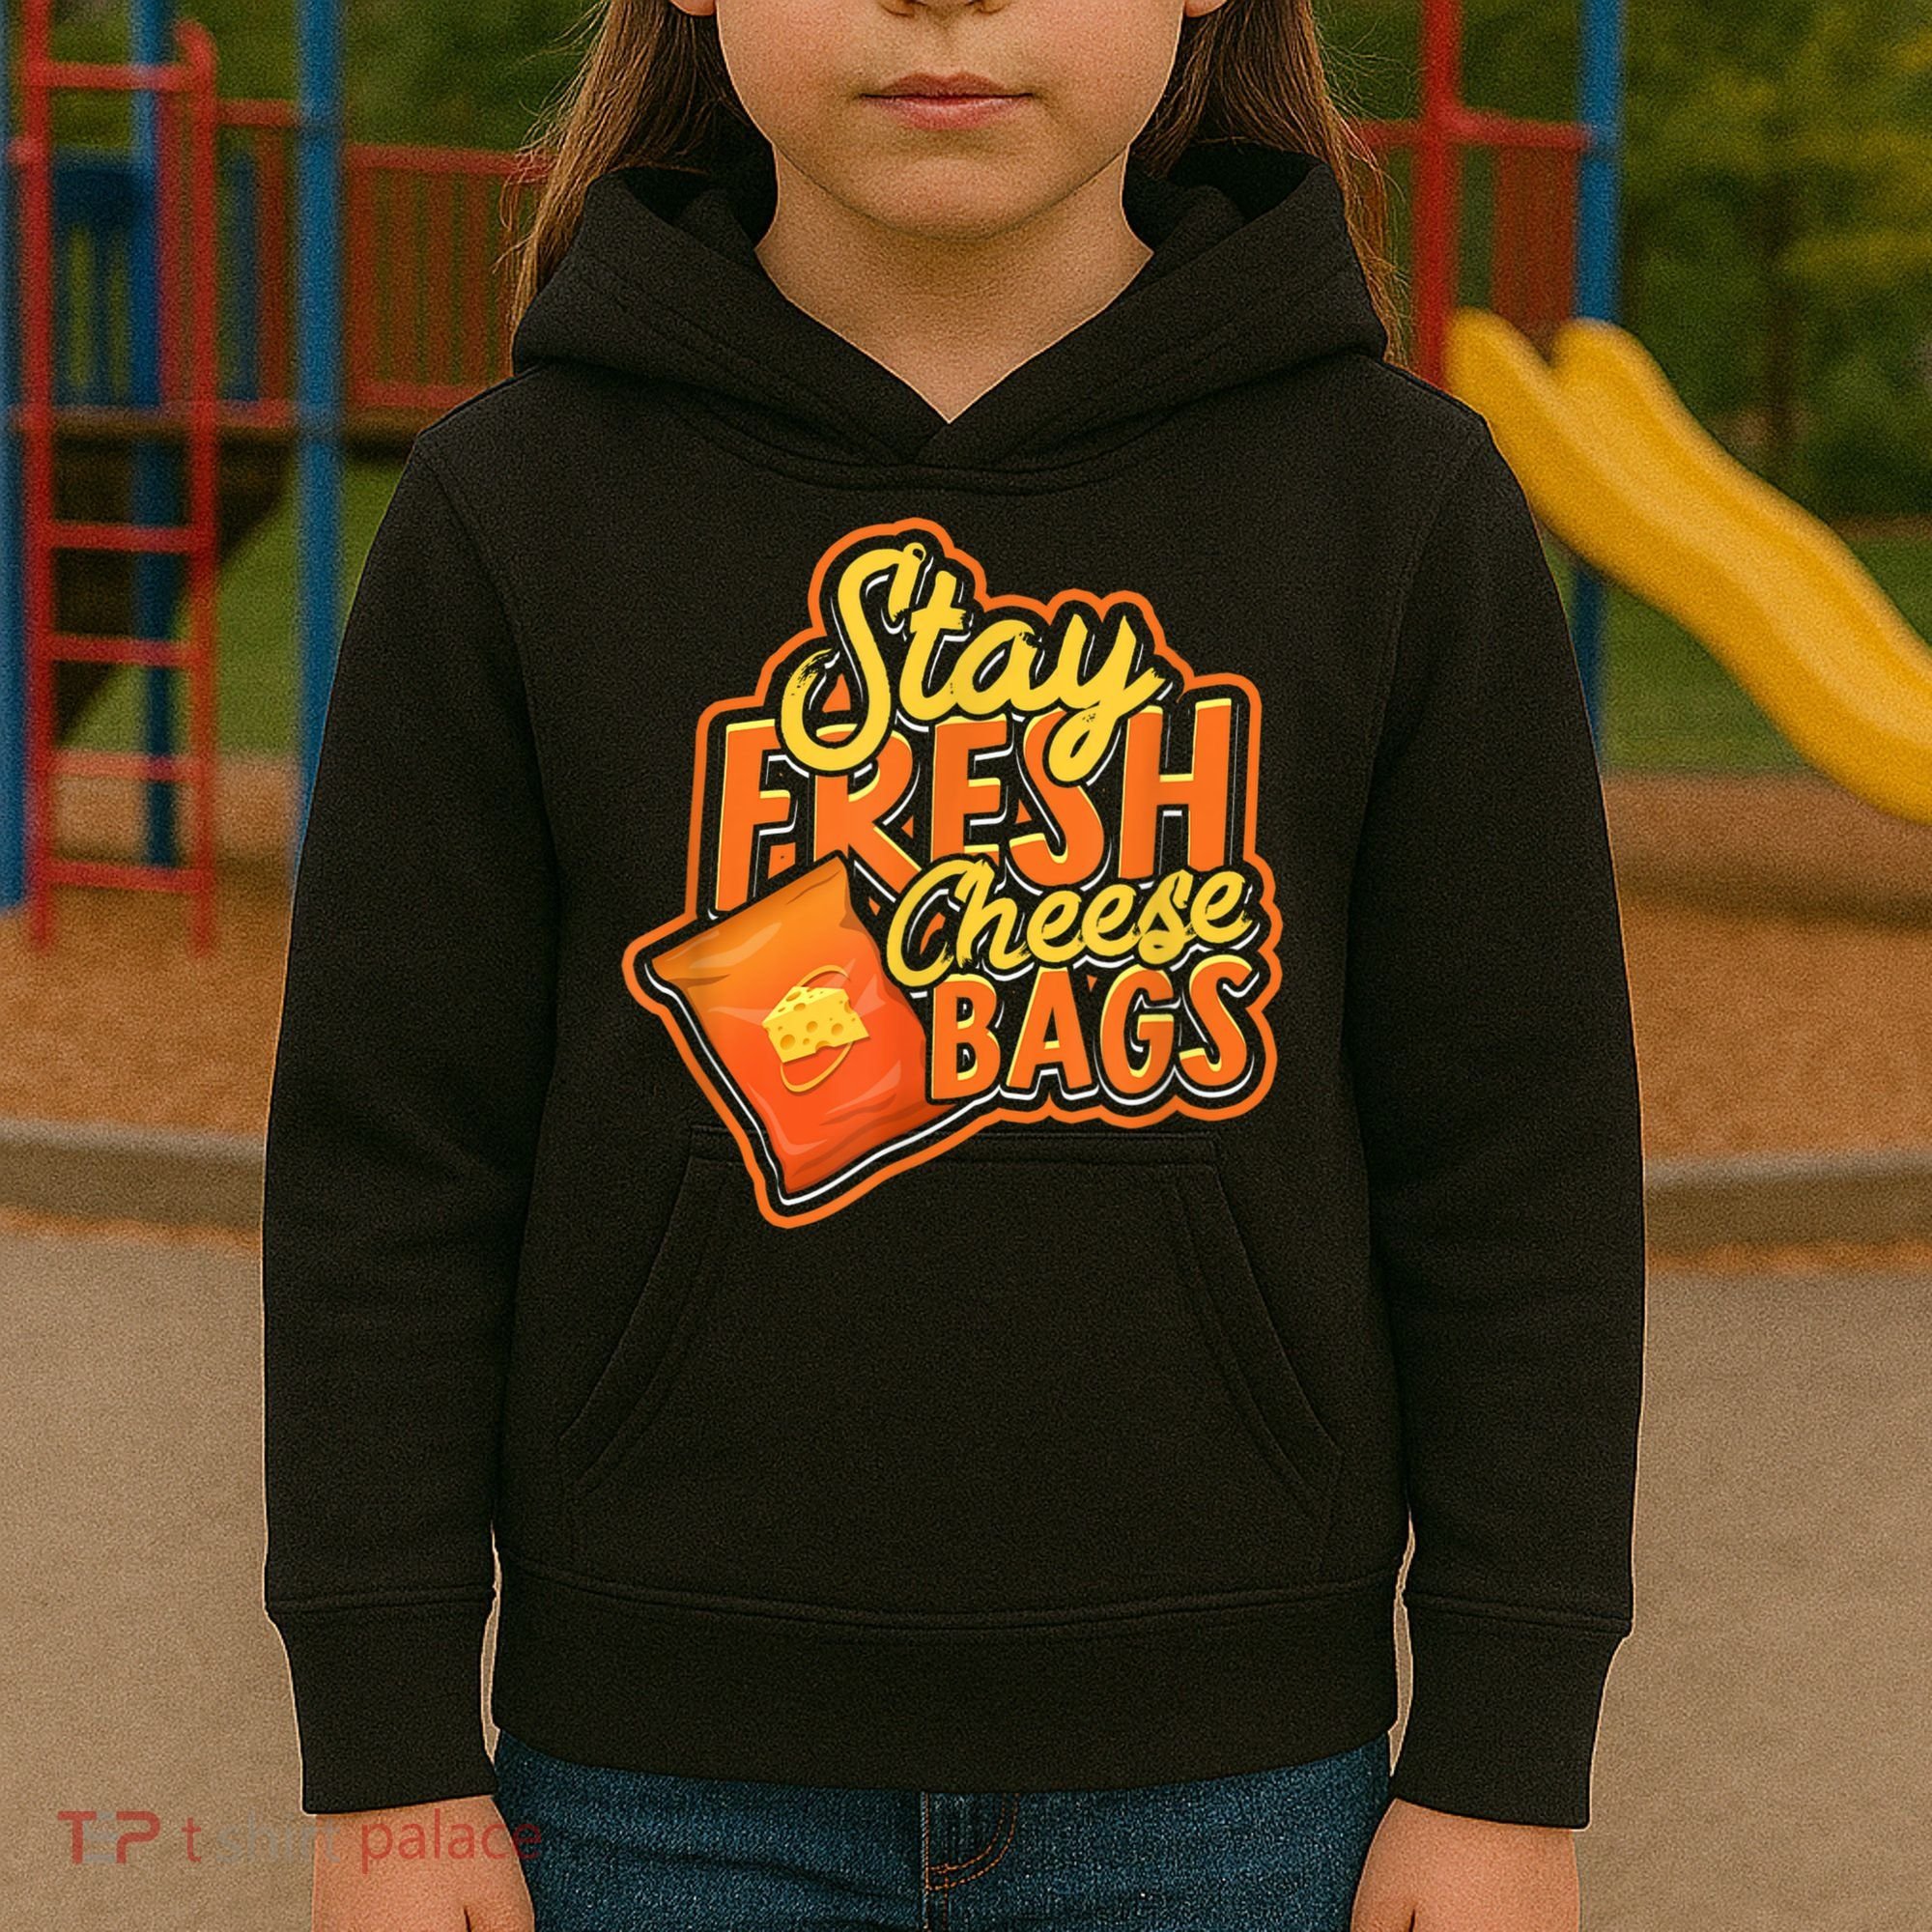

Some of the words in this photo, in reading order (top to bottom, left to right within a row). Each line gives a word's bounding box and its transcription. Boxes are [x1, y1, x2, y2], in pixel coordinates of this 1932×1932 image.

[781, 542, 1167, 782] Stay
[715, 697, 1233, 913] FRESH
[887, 859, 1253, 987] Cheese
[930, 954, 1253, 1100] BAGS
